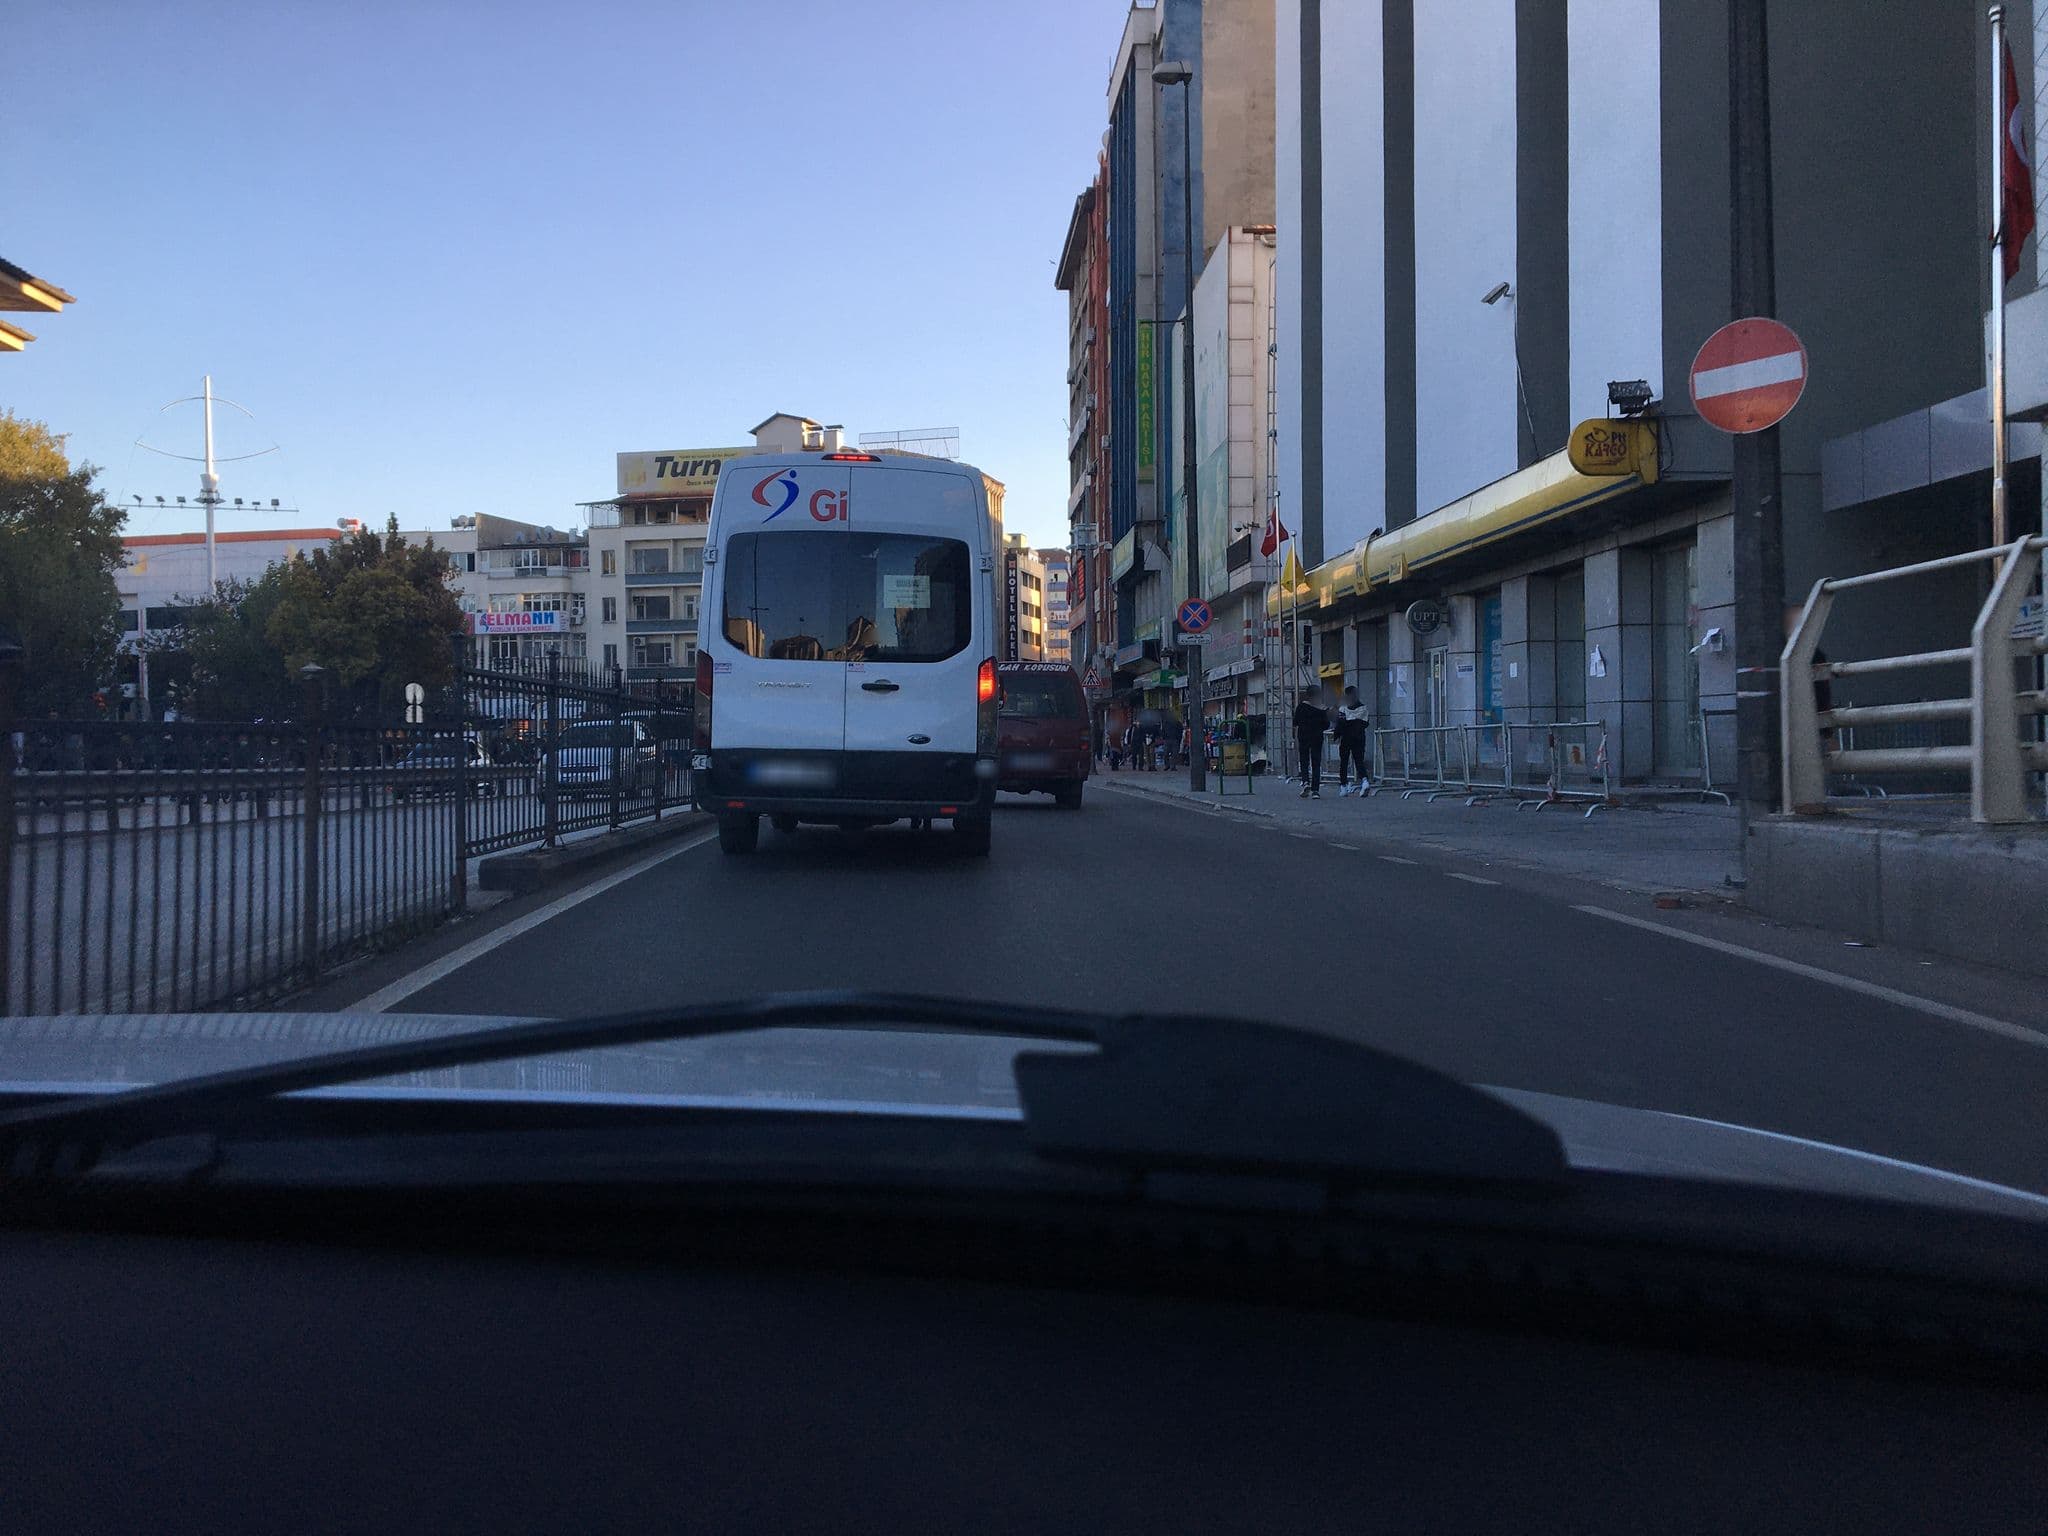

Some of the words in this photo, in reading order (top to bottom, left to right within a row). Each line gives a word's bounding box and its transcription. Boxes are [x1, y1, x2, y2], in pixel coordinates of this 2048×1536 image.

[655, 456, 721, 478] Turn
[809, 489, 848, 521] Gi
[1008, 569, 1016, 612] HOTEL
[1413, 611, 1438, 621] UPT
